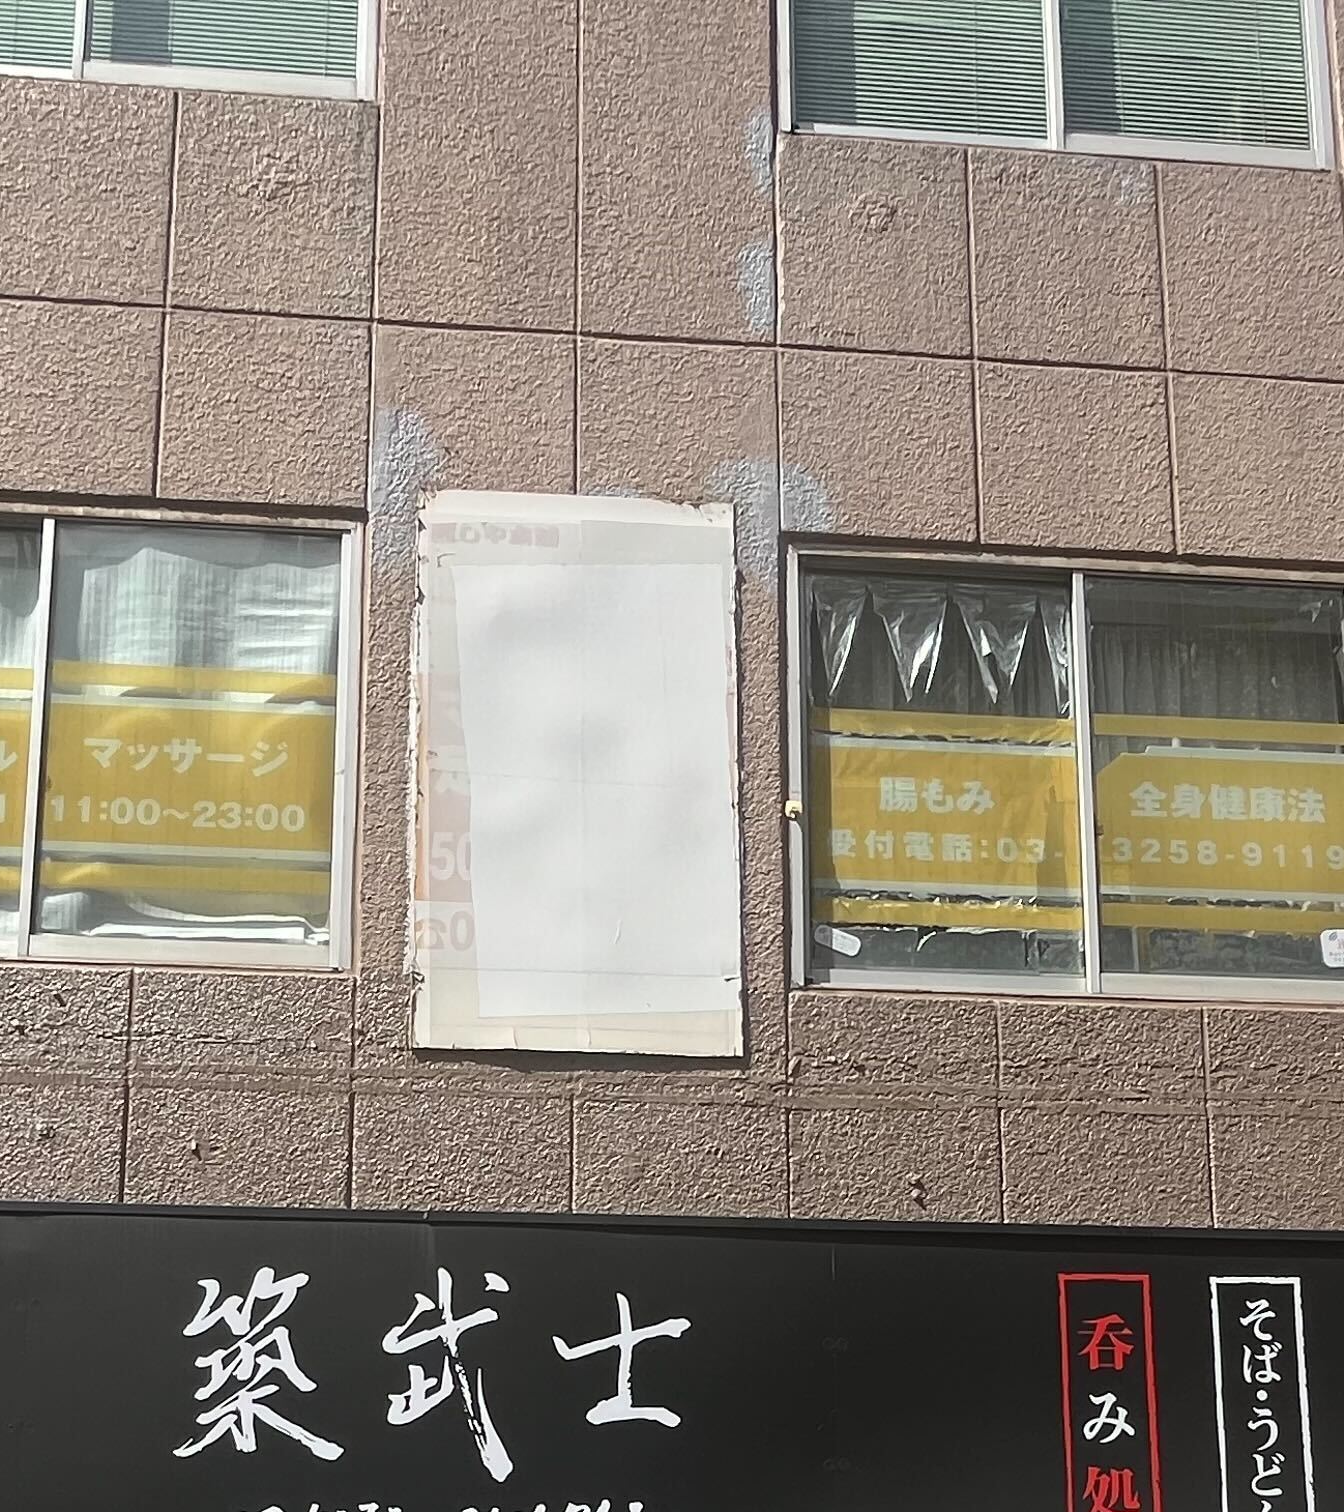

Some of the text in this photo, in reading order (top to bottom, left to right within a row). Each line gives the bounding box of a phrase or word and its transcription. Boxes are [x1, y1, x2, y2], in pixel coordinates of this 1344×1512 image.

[84, 735, 291, 778] マッサージ
[878, 776, 995, 816] 腸もみ
[1130, 781, 1327, 825] 全身健康法
[172, 1266, 692, 1484] 築武士
